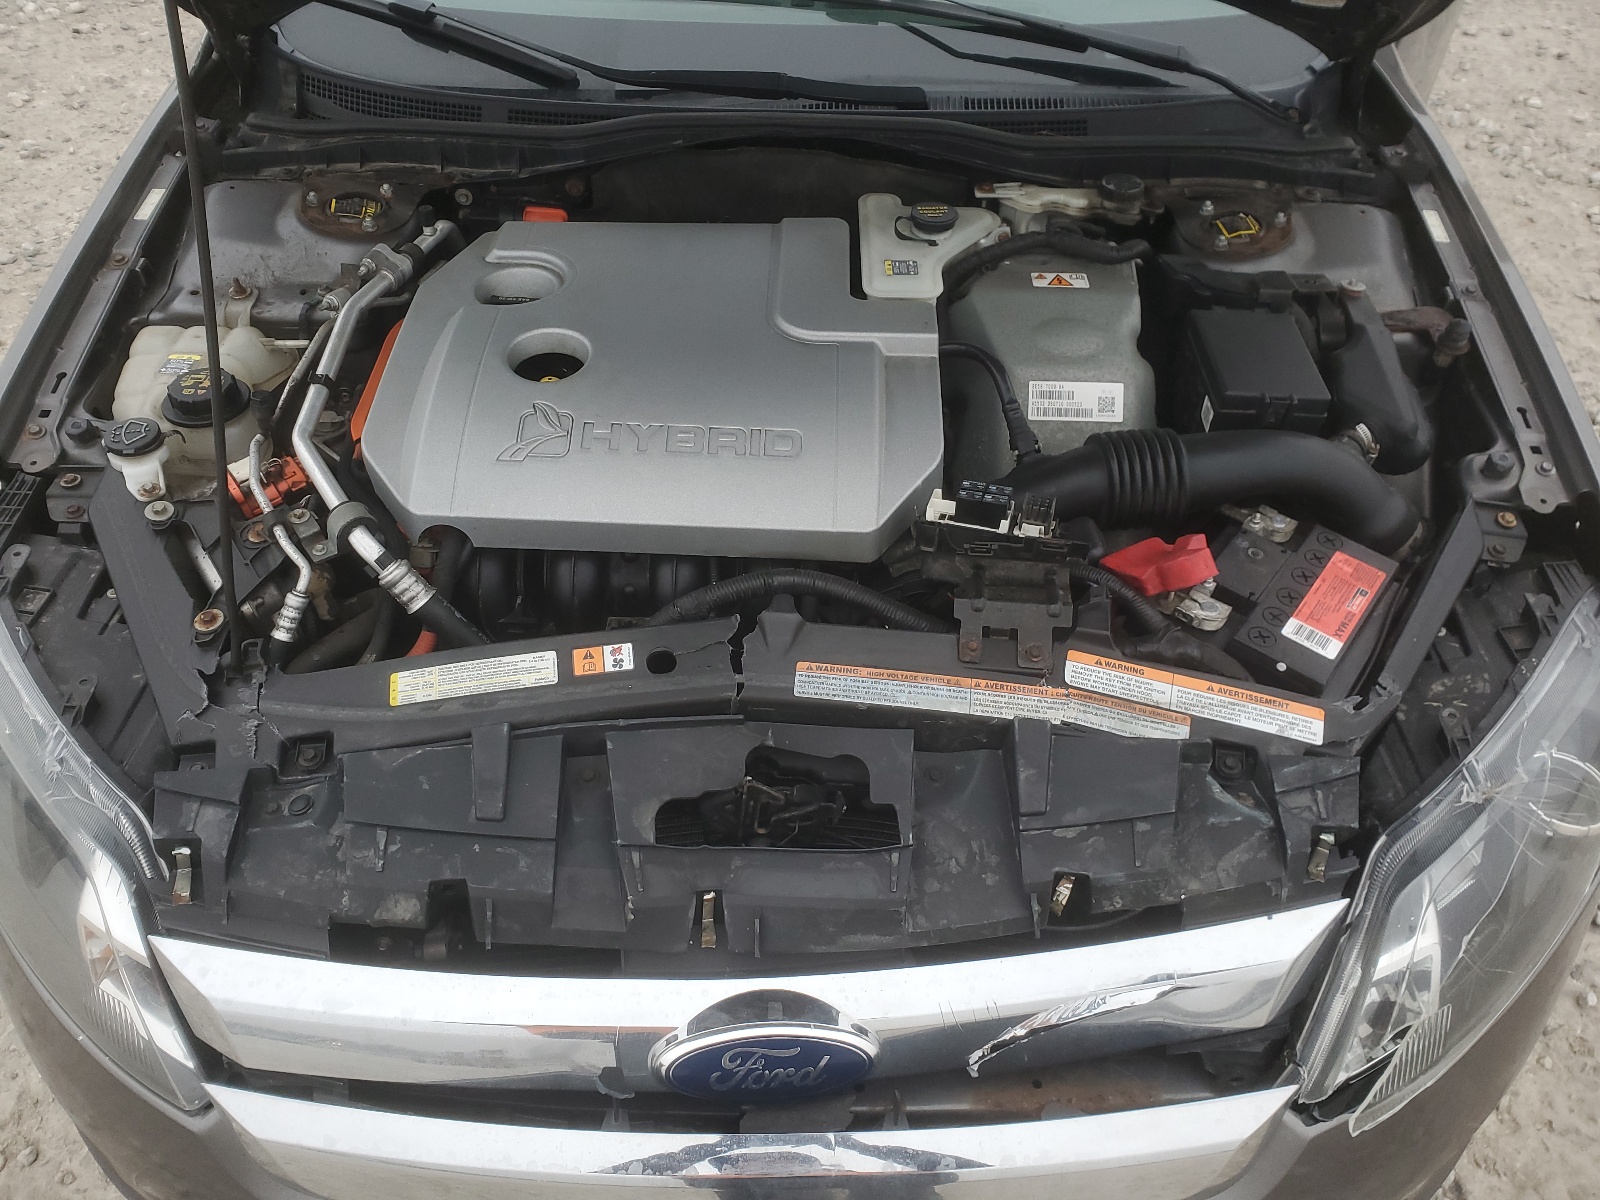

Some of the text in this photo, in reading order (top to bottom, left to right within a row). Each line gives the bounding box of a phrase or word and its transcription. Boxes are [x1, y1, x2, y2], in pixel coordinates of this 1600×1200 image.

[580, 421, 803, 458] HYBRID
[1332, 620, 1350, 640] MAX
[815, 665, 861, 675] WARNING:
[886, 671, 918, 680] VOLTAGE
[920, 675, 951, 684] VEHICLE
[1104, 660, 1144, 675] WARNING
[984, 681, 1048, 695] AVERTISSEMENT
[1217, 686, 1289, 709] AVERTISSEMENT
[709, 1047, 831, 1091] Ford
